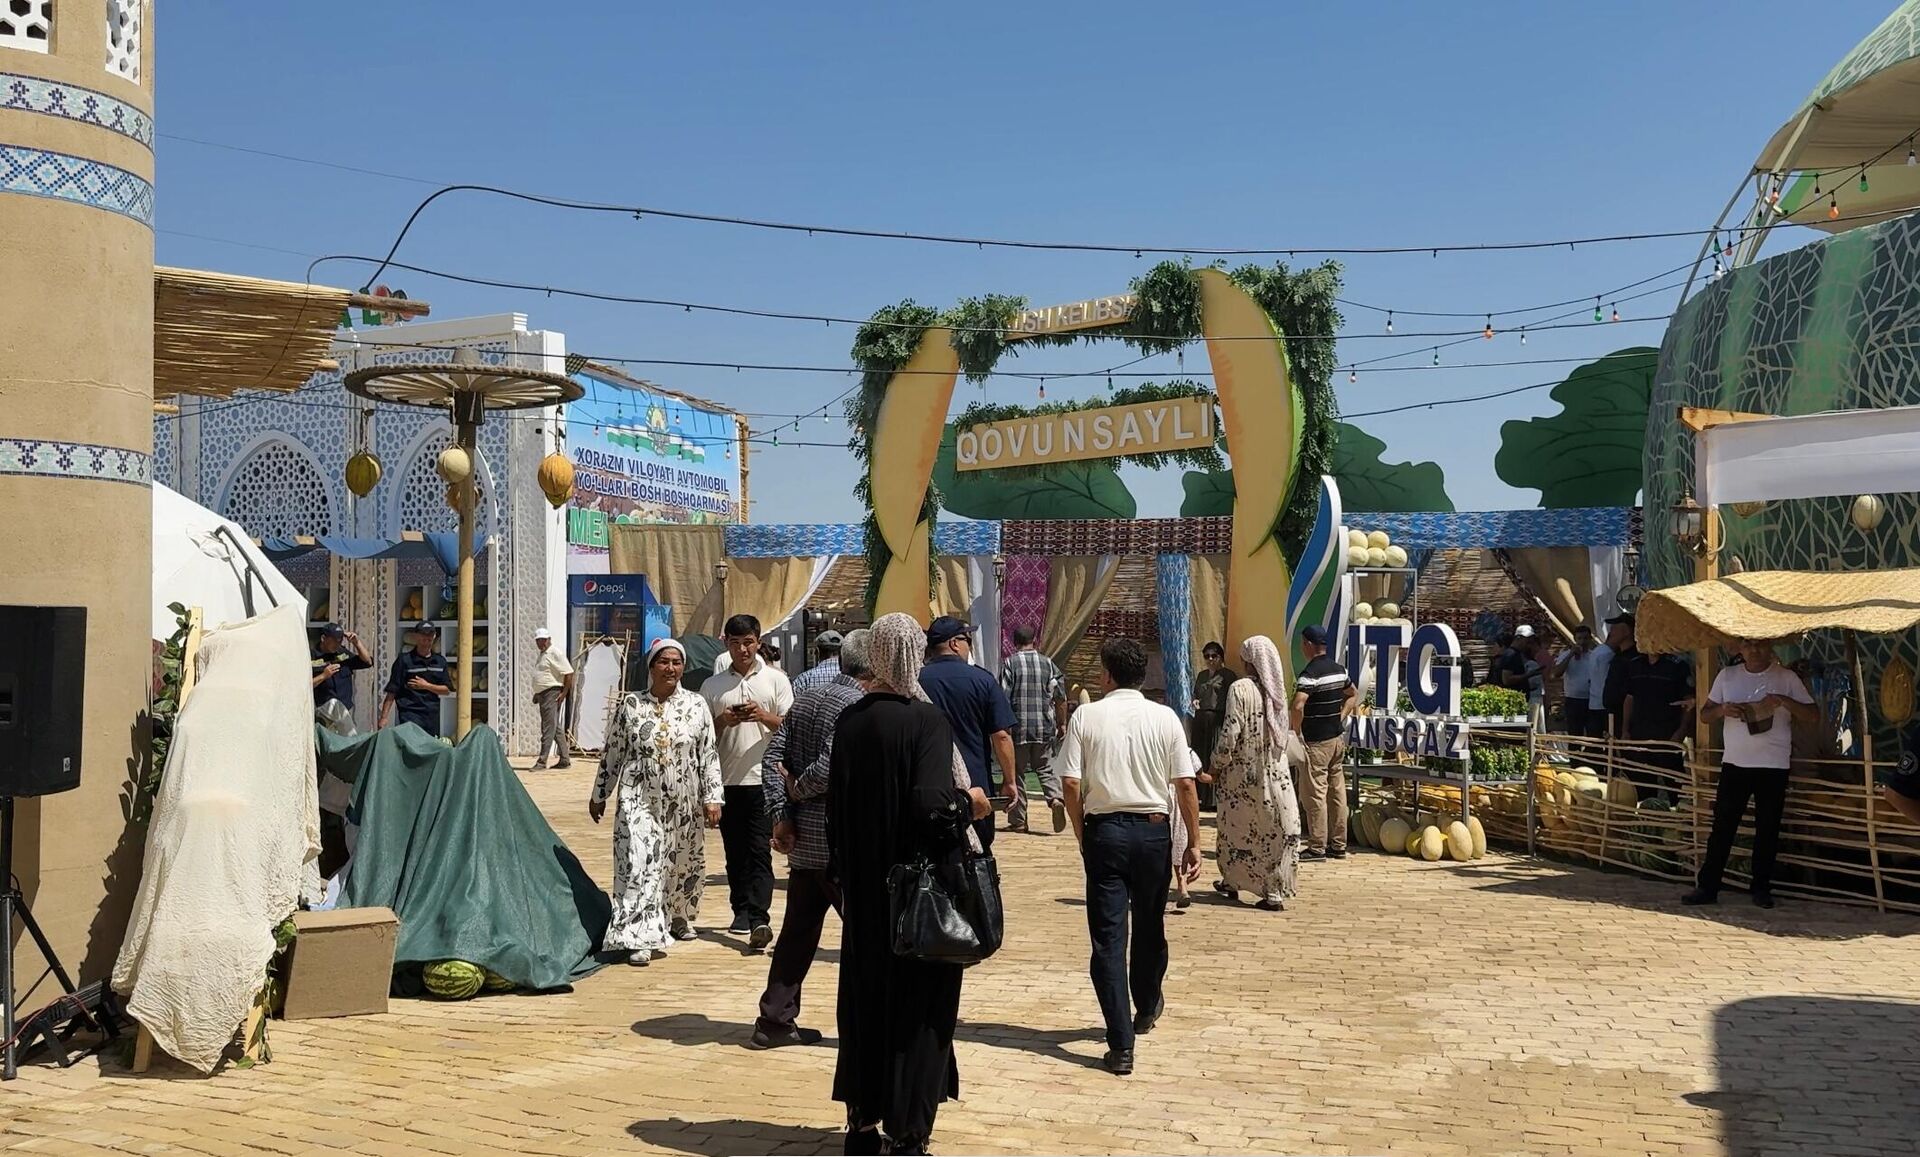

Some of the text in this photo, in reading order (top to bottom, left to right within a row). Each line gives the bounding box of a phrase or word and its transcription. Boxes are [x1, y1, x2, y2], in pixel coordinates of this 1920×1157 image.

[1006, 308, 1051, 332] USH
[628, 458, 674, 482] VILOYATI
[677, 469, 729, 492] AVTOMOBIL
[631, 483, 662, 501] BOSH
[665, 491, 730, 514] BOSHQARMASI
[599, 583, 626, 594] pepsi
[1346, 715, 1469, 759] ANSGAZ
